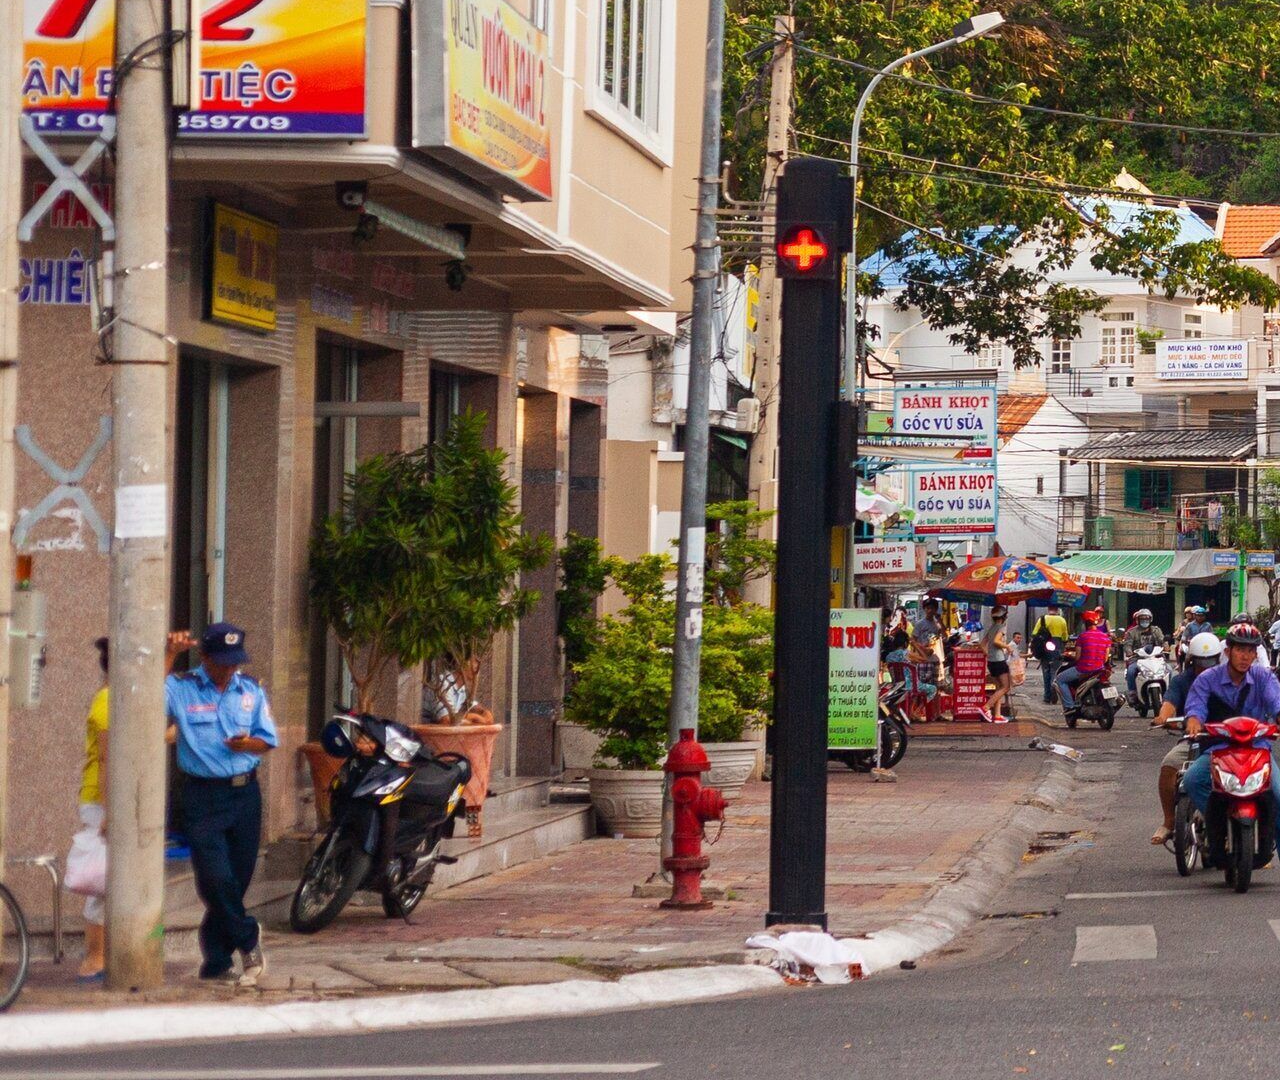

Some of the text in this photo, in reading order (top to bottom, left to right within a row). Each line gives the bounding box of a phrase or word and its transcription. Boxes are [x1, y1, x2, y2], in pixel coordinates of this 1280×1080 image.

[200, 63, 296, 107] TIỆC
[538, 58, 546, 127] 2
[901, 393, 990, 411] BÁNH KHỌT
[902, 412, 931, 431] GỐC
[934, 413, 953, 431] VÚ
[919, 472, 994, 493] BÁNH KHỌT
[918, 495, 944, 511] GỐC
[948, 496, 964, 511] VÚ
[856, 546, 870, 555] BÁNH
[862, 560, 886, 570] NGON
[845, 621, 877, 650] THƯ
